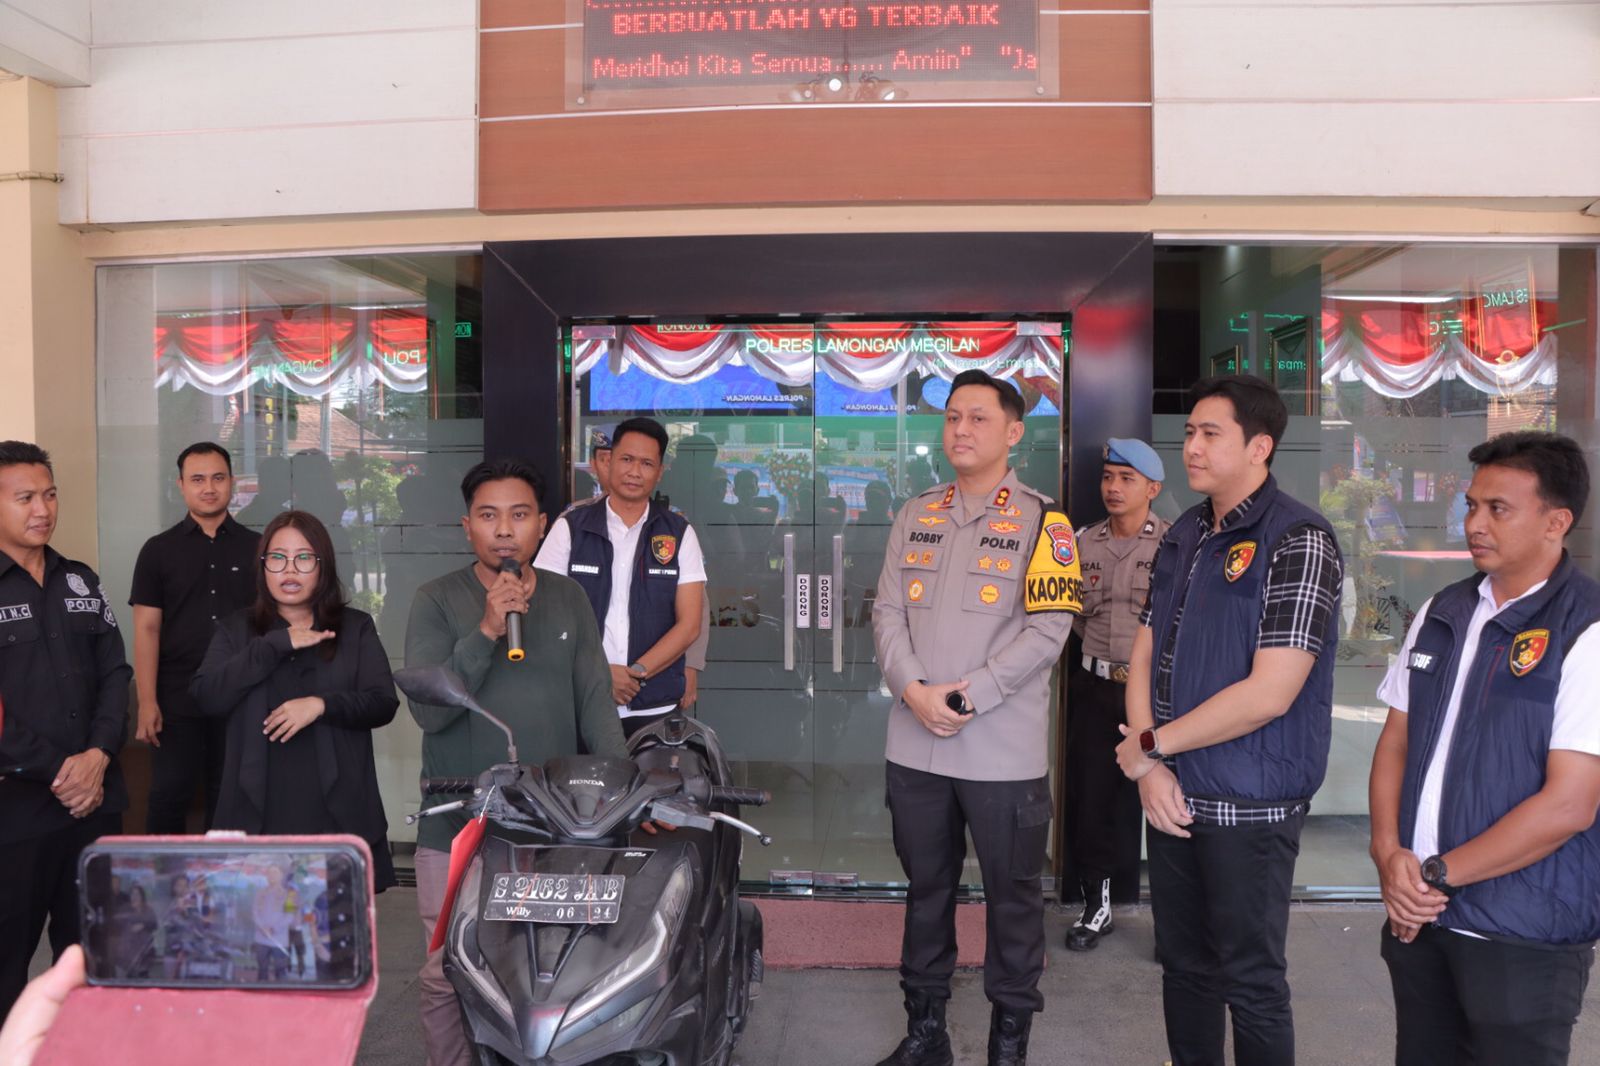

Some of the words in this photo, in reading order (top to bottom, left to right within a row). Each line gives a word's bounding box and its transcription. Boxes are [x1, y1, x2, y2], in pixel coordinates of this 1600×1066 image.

[613, 8, 810, 35] BERBUATLAH
[819, 7, 857, 28] YG
[867, 4, 999, 27] TERBAIK
[592, 53, 689, 79] Meridhoi
[698, 54, 742, 75] Kita
[745, 338, 813, 353] POLRES
[817, 338, 907, 353] LAMONGAN
[910, 337, 980, 353] MEGILAN
[908, 531, 944, 545] BOBBY
[979, 537, 1020, 551] POLRI
[569, 779, 605, 787] HONDA
[494, 876, 510, 899] S
[556, 907, 575, 919] 06
